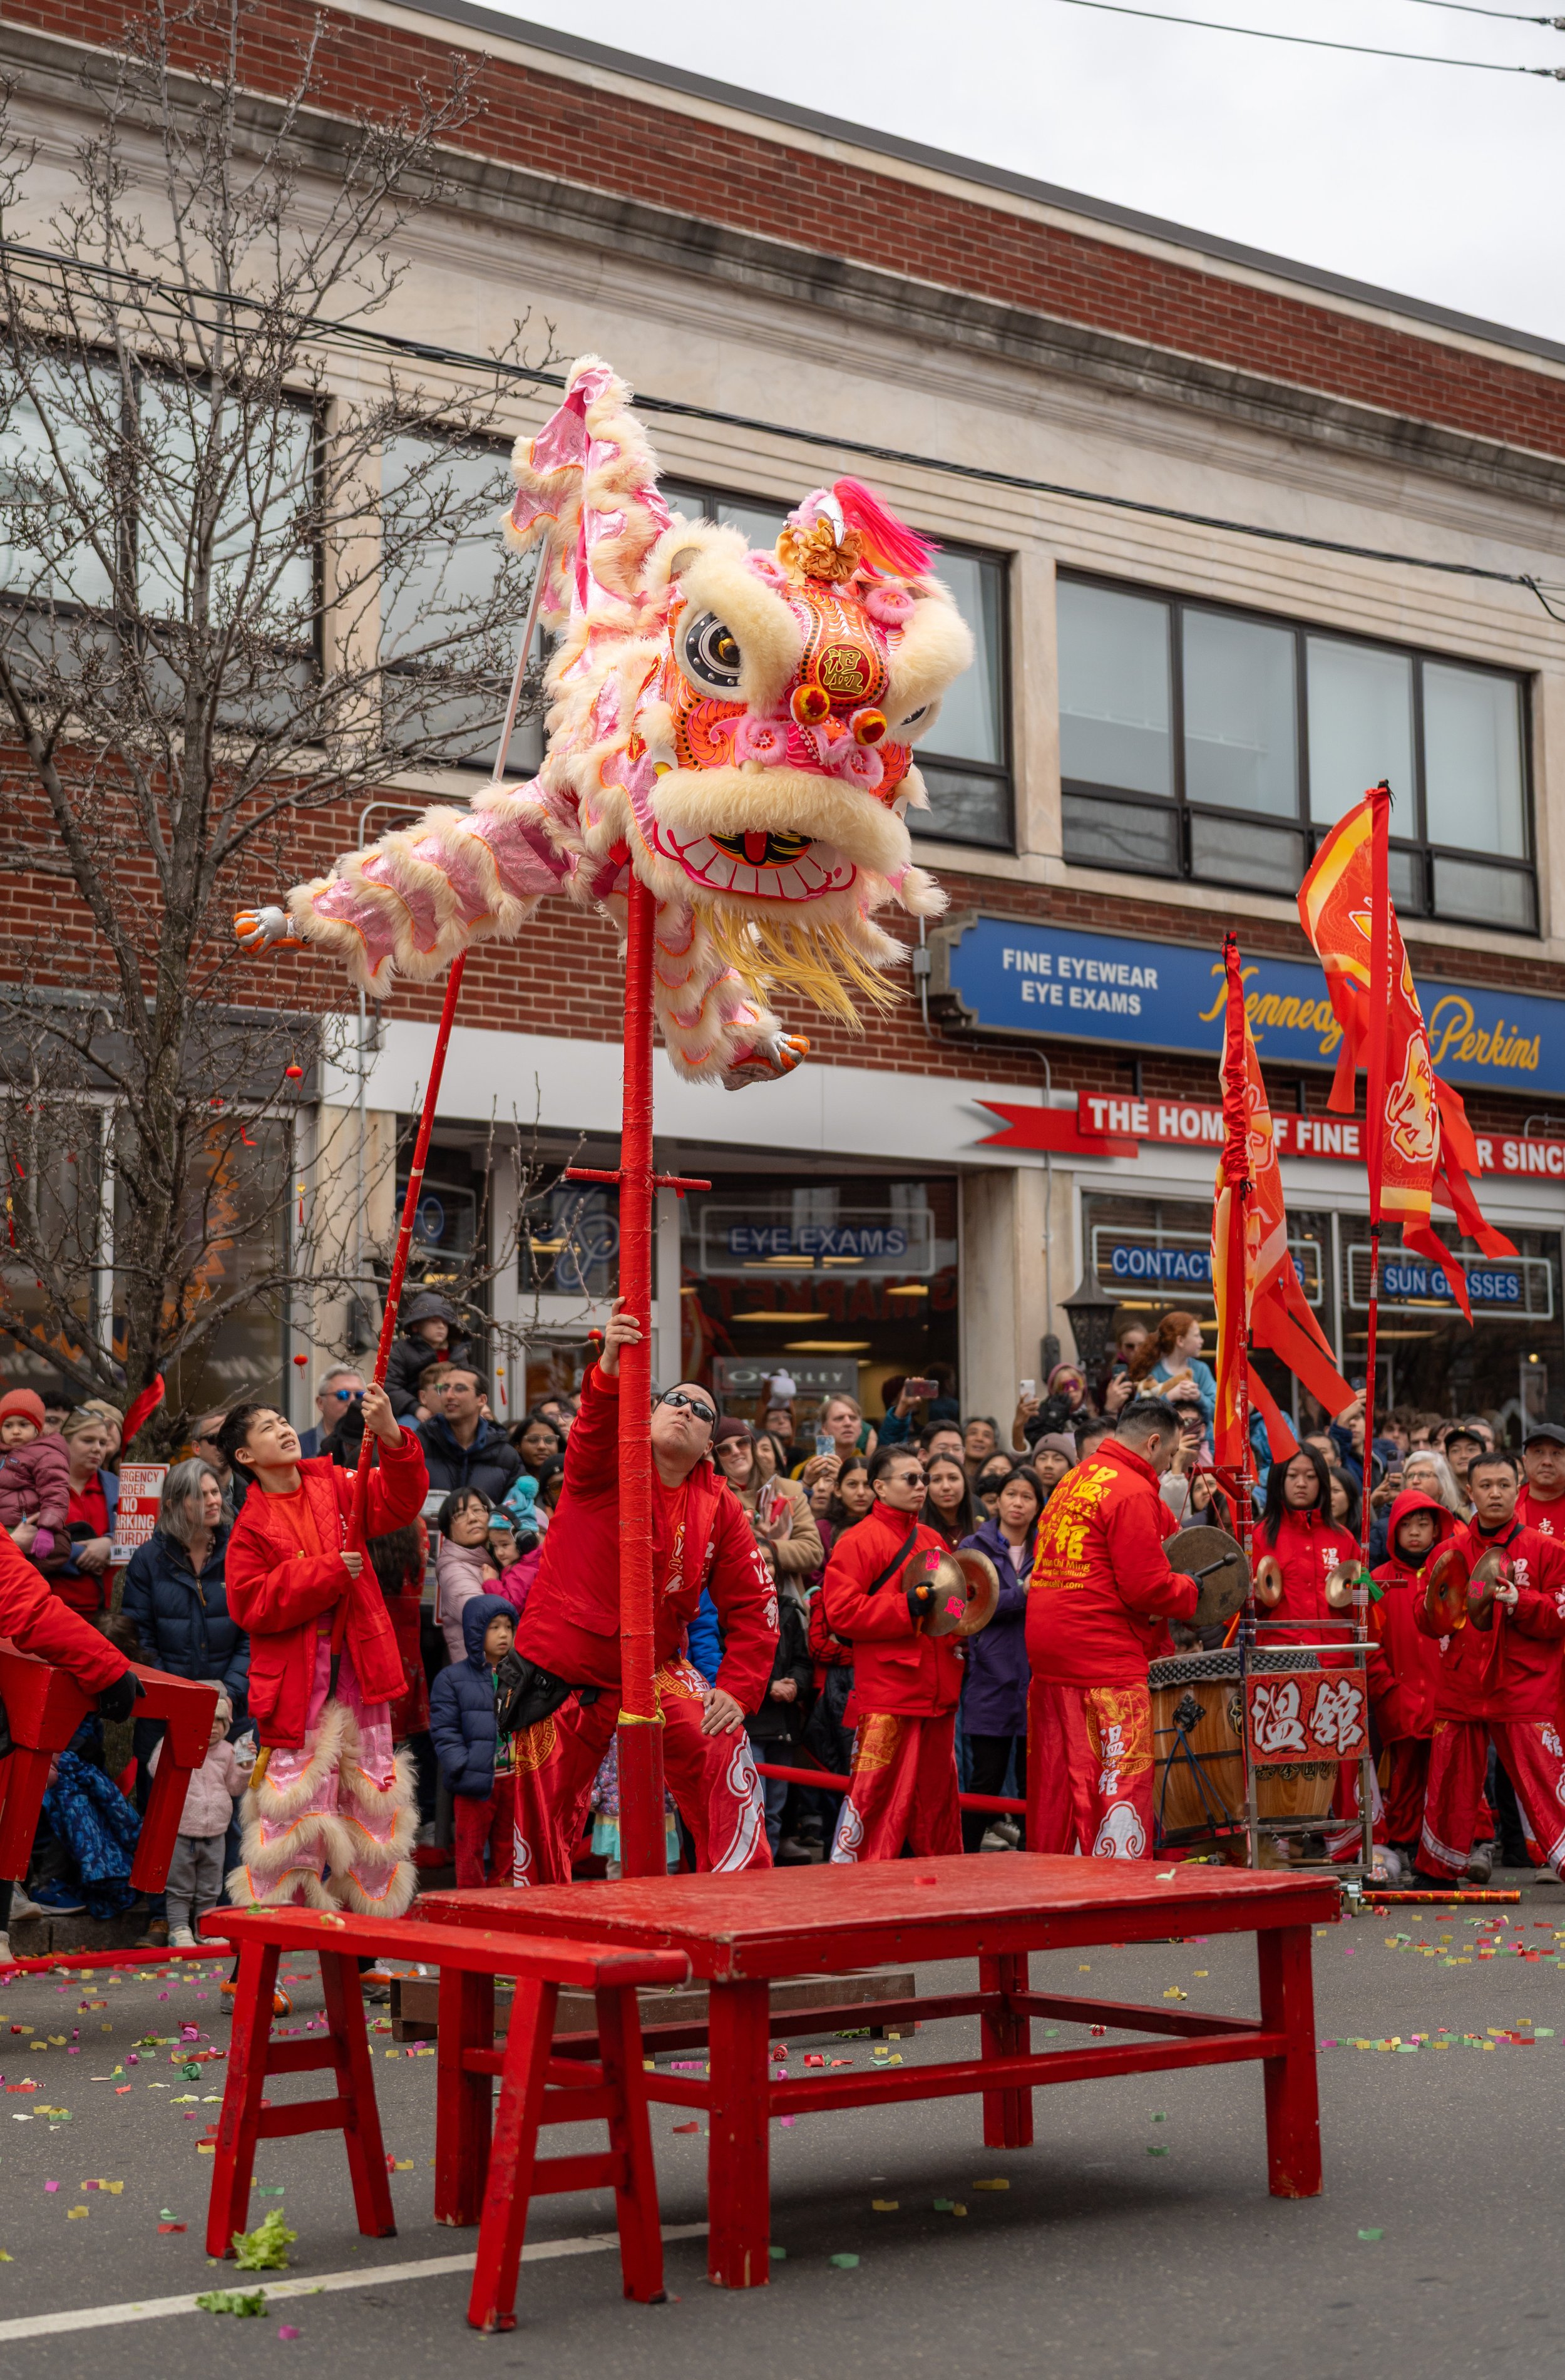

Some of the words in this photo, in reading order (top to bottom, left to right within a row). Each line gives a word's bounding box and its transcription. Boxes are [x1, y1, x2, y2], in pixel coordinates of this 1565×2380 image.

[1003, 948, 1052, 976] FINE
[1058, 956, 1157, 989] EYEWEAR
[1022, 980, 1063, 1006] EYE
[1069, 986, 1141, 1016] EXAMS
[1428, 994, 1541, 1071] Perkins
[1088, 1097, 1149, 1134] THE
[1158, 1105, 1224, 1141] HOM
[1296, 1121, 1360, 1156] FINE
[1502, 1140, 1565, 1175] SINC
[731, 1228, 790, 1252] EYE
[799, 1229, 905, 1254] EXAMS
[1385, 1266, 1427, 1293] SUN
[1431, 1270, 1519, 1299] GLSSES
[729, 1370, 843, 1384] OKLEY
[120, 1471, 160, 1483] ERGENCY
[121, 1497, 138, 1513] NO
[116, 1513, 155, 1530] ARKING
[114, 1531, 153, 1545] TURDA
[1054, 1558, 1064, 1567] Chi
[1066, 1560, 1091, 1572] Ming
[1030, 1578, 1084, 1589] ionDanceNY.com
